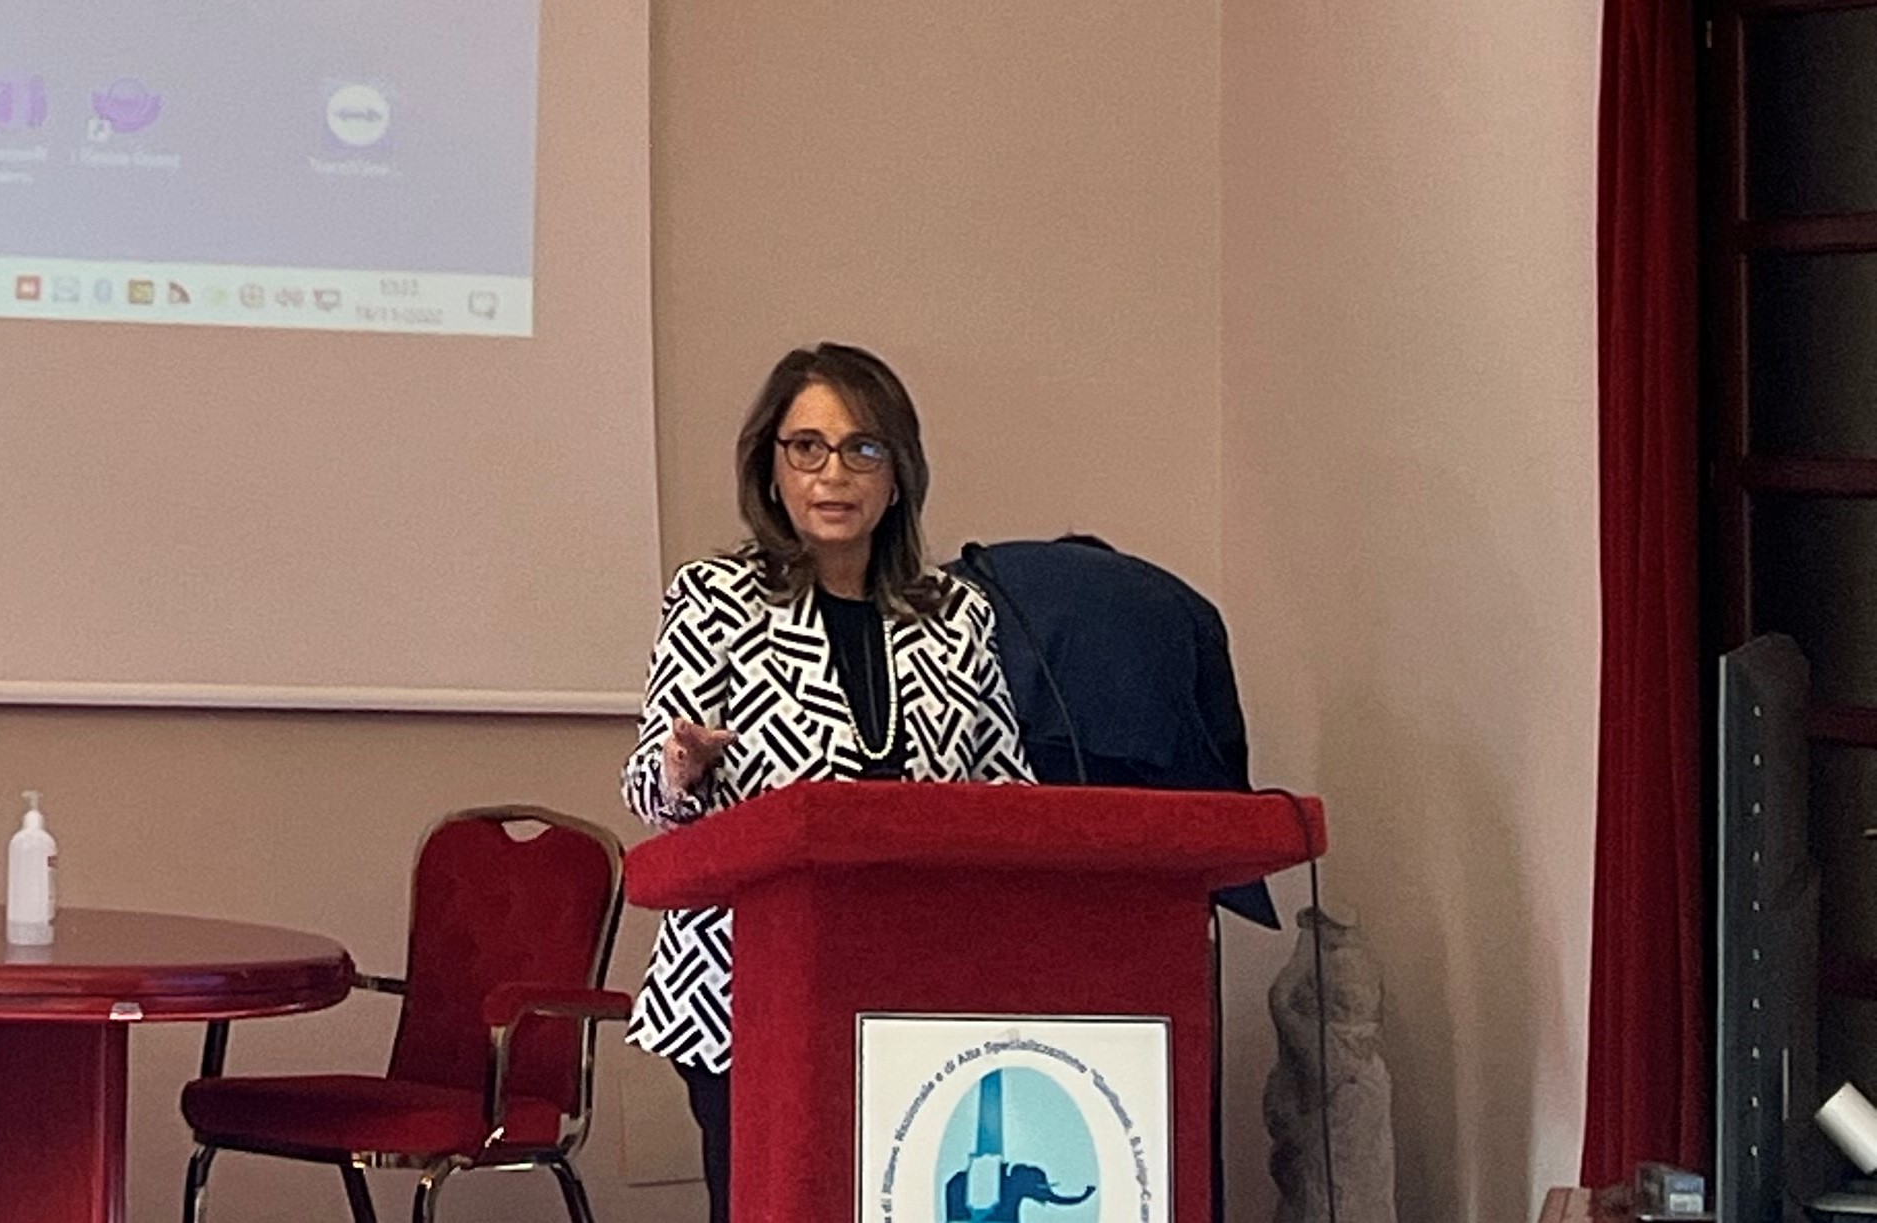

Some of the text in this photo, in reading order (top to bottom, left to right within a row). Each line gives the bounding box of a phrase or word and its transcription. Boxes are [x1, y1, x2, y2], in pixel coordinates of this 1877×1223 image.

[894, 1080, 936, 1142] Nazionale
[944, 1059, 957, 1076] di
[957, 1048, 981, 1065] Alta
